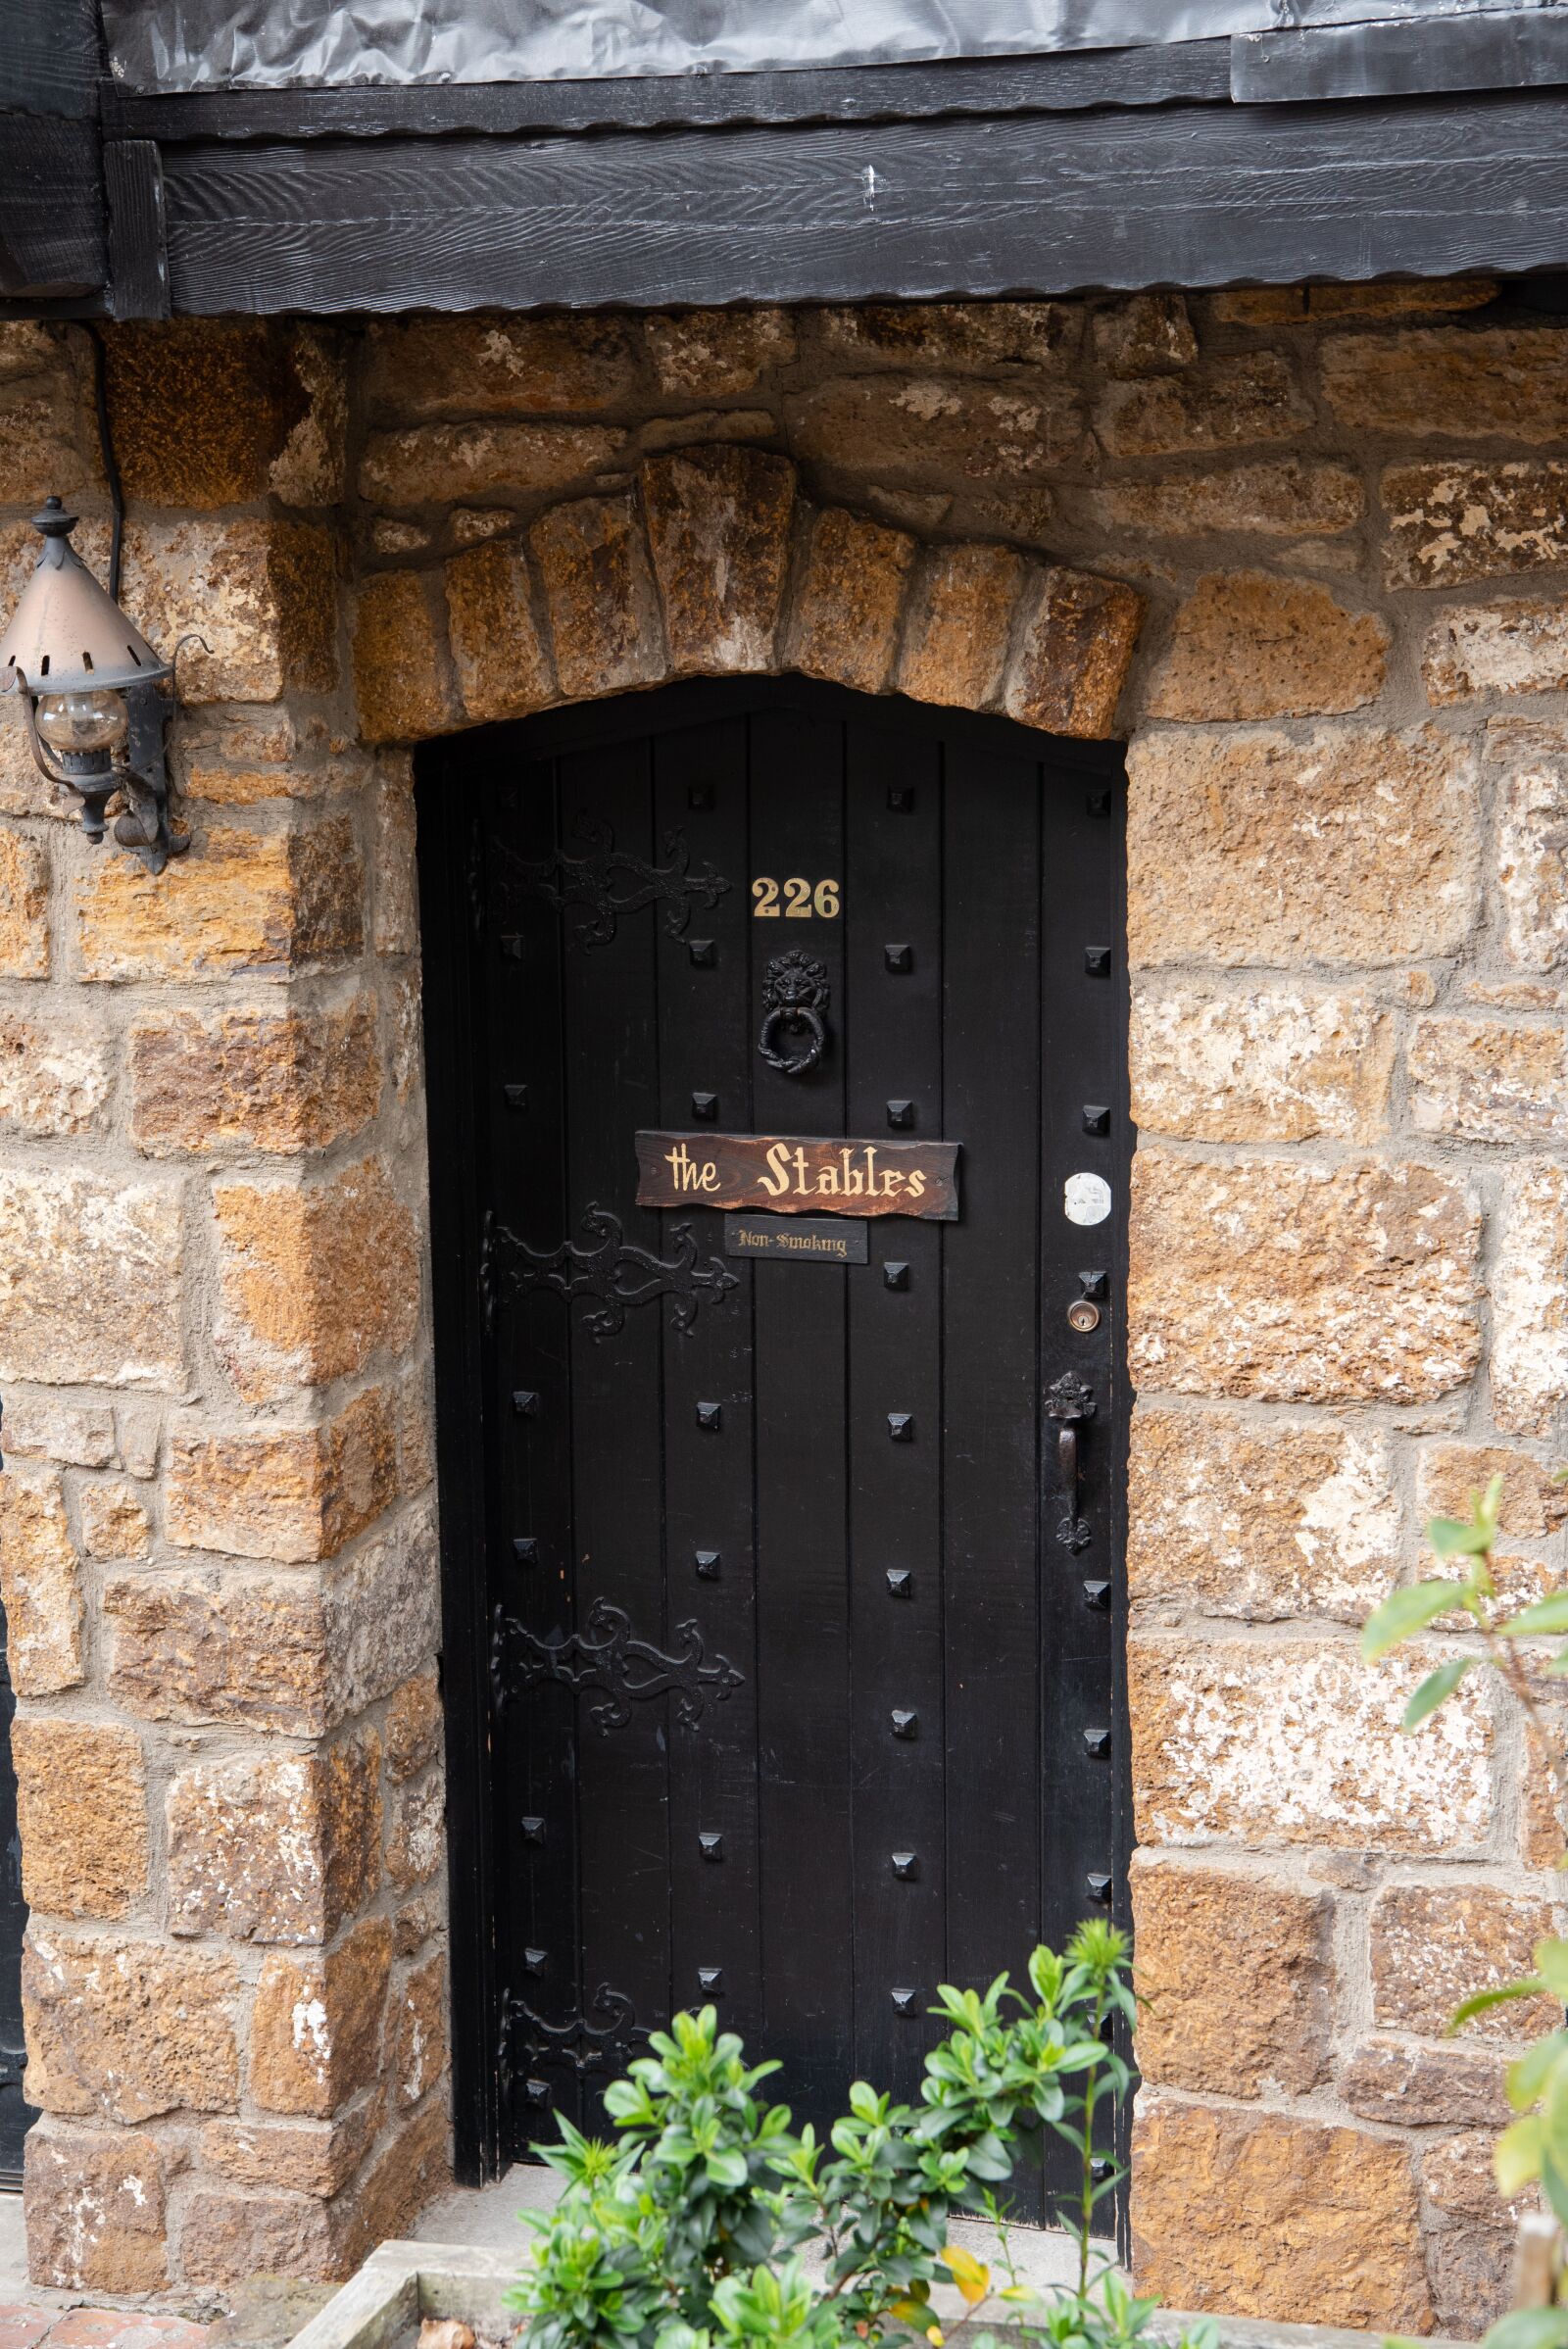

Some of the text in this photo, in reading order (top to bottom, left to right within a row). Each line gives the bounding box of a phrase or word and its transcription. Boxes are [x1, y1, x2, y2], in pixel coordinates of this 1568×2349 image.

[752, 877, 840, 918] 226
[664, 1143, 927, 1198] the Stables
